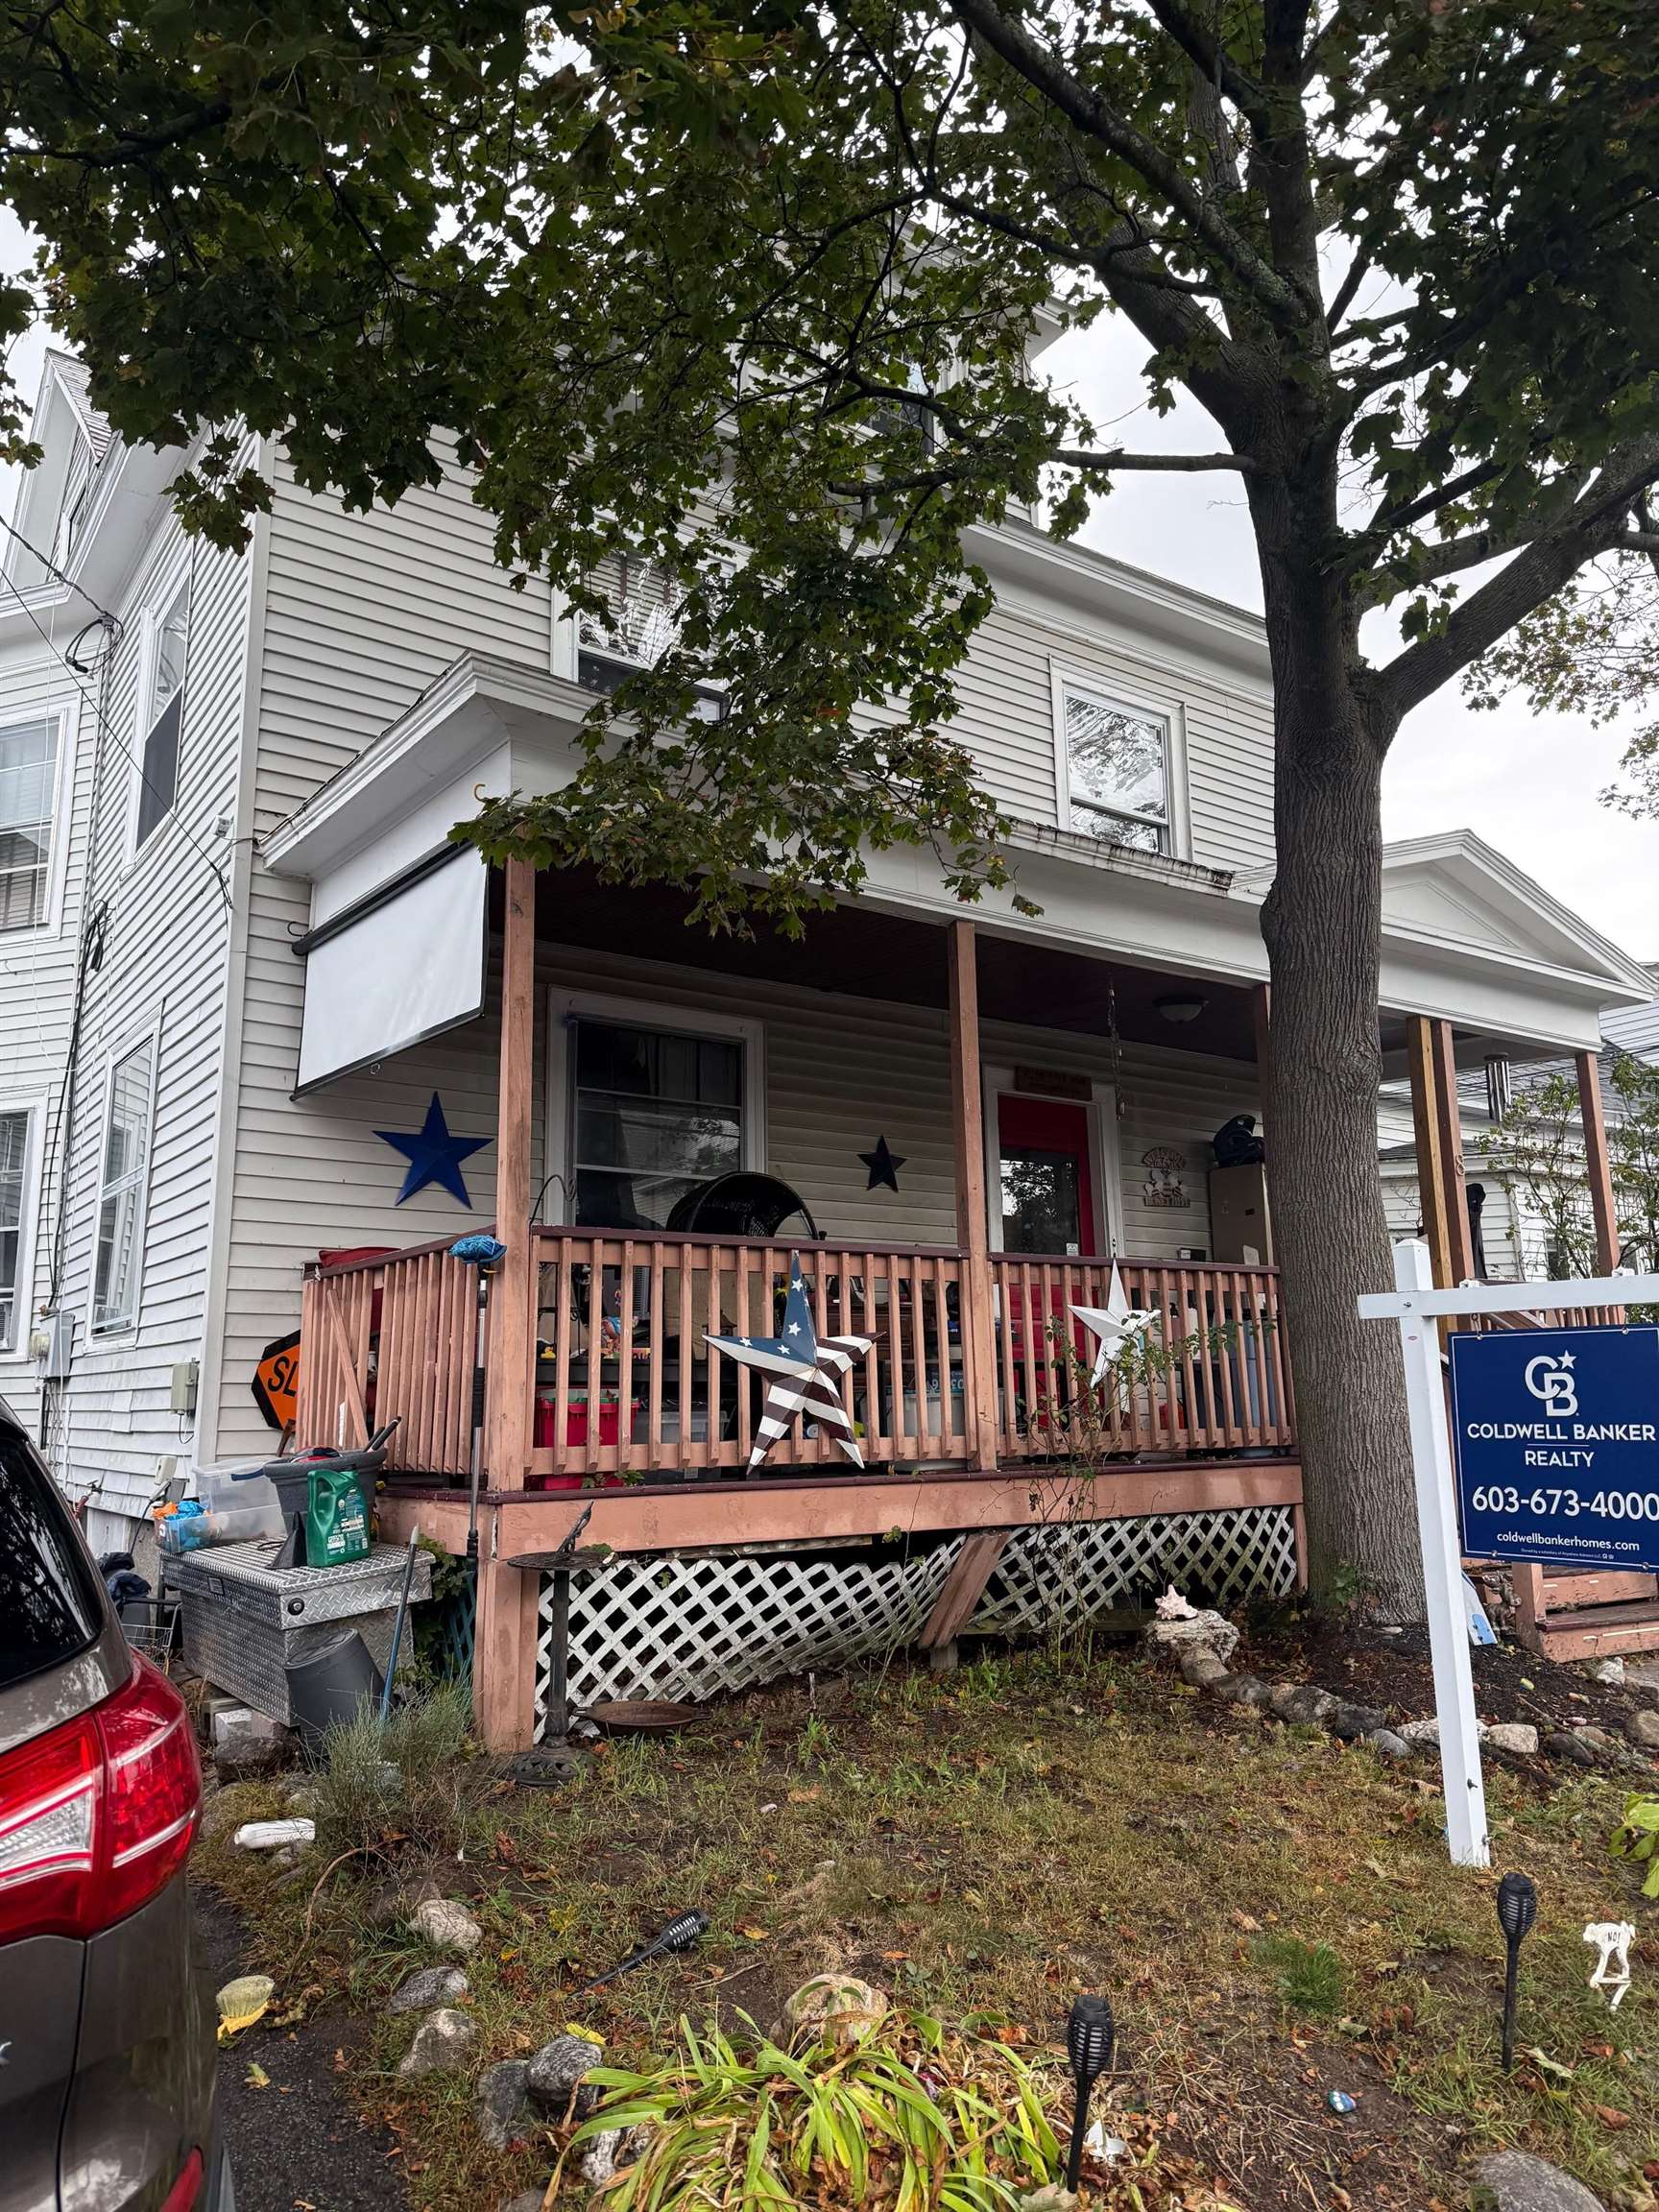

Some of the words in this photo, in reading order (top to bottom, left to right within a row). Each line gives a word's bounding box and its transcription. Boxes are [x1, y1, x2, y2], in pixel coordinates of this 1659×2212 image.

[1455, 1153, 1466, 1176] 8
[267, 1355, 298, 1397] SL
[1467, 1423, 1568, 1440] COLDWELL
[1573, 1424, 1656, 1441] BANKER
[1525, 1450, 1595, 1468] REALTY
[1472, 1485, 1659, 1522] 603-673-4000
[1497, 1531, 1640, 1551] coldwellbankerhomes.com
